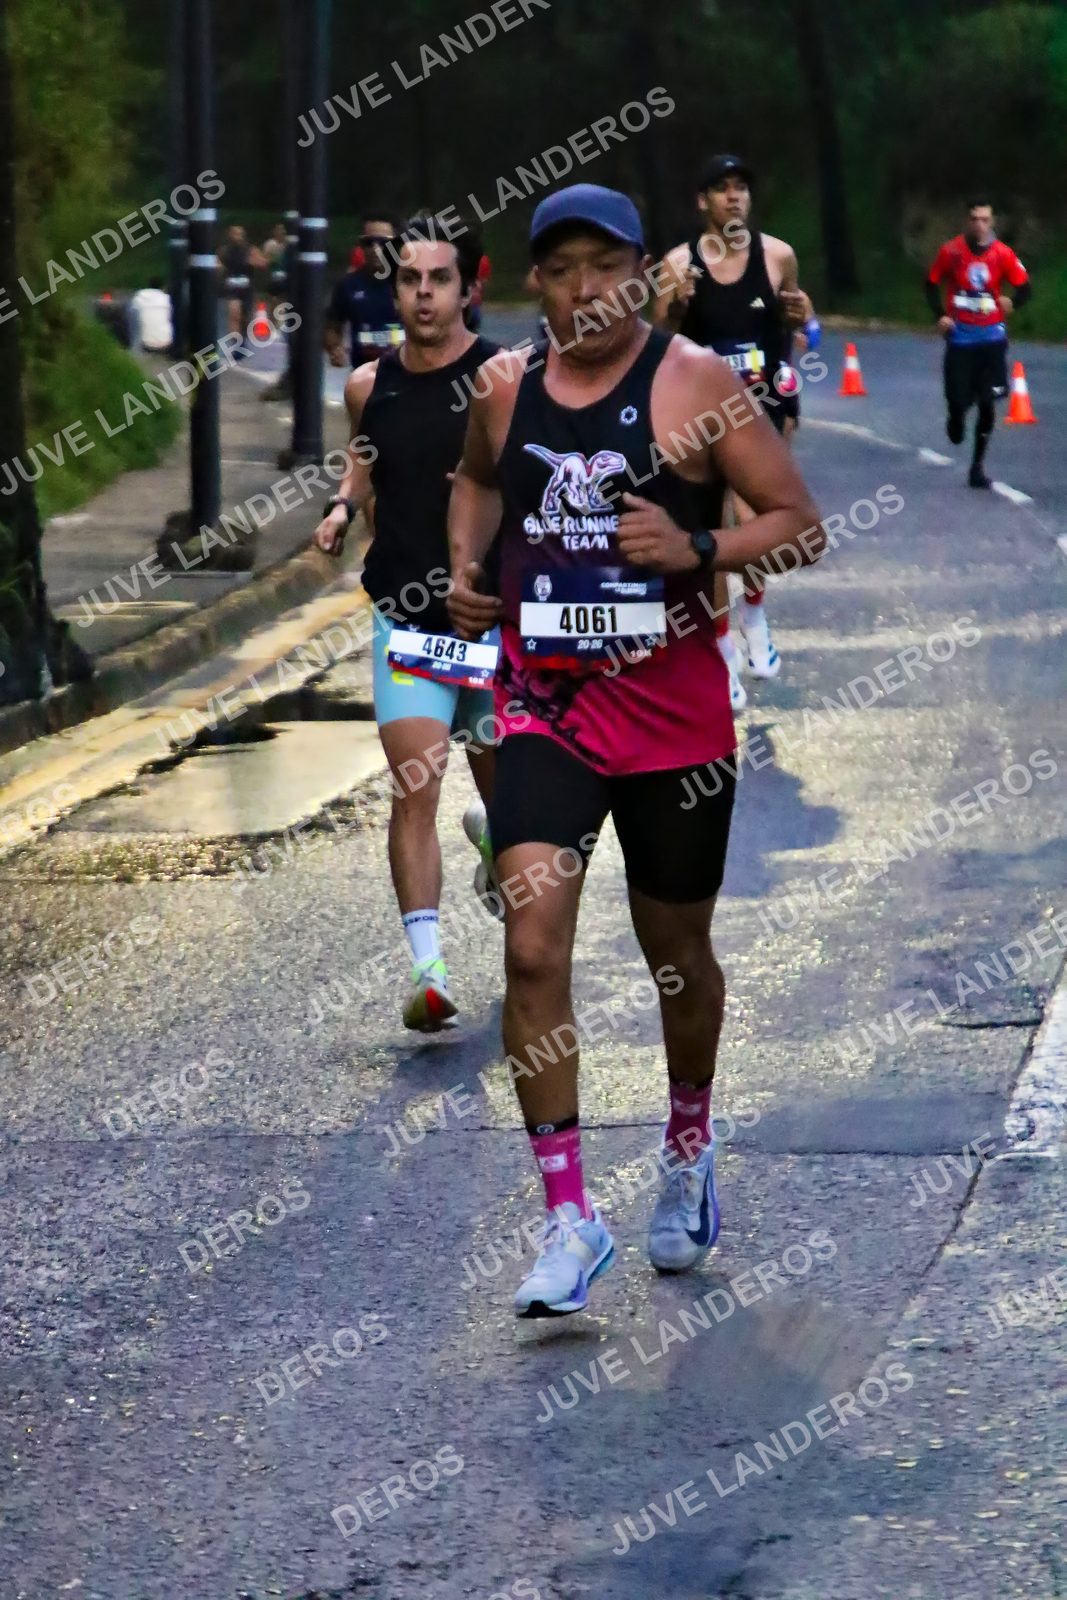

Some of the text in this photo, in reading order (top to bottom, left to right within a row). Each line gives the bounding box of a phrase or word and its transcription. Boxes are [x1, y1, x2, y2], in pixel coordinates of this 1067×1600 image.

[523, 516, 561, 534] BLUE
[563, 535, 609, 550] TEAM
[560, 605, 618, 634] 4061
[422, 636, 467, 662] 4643
